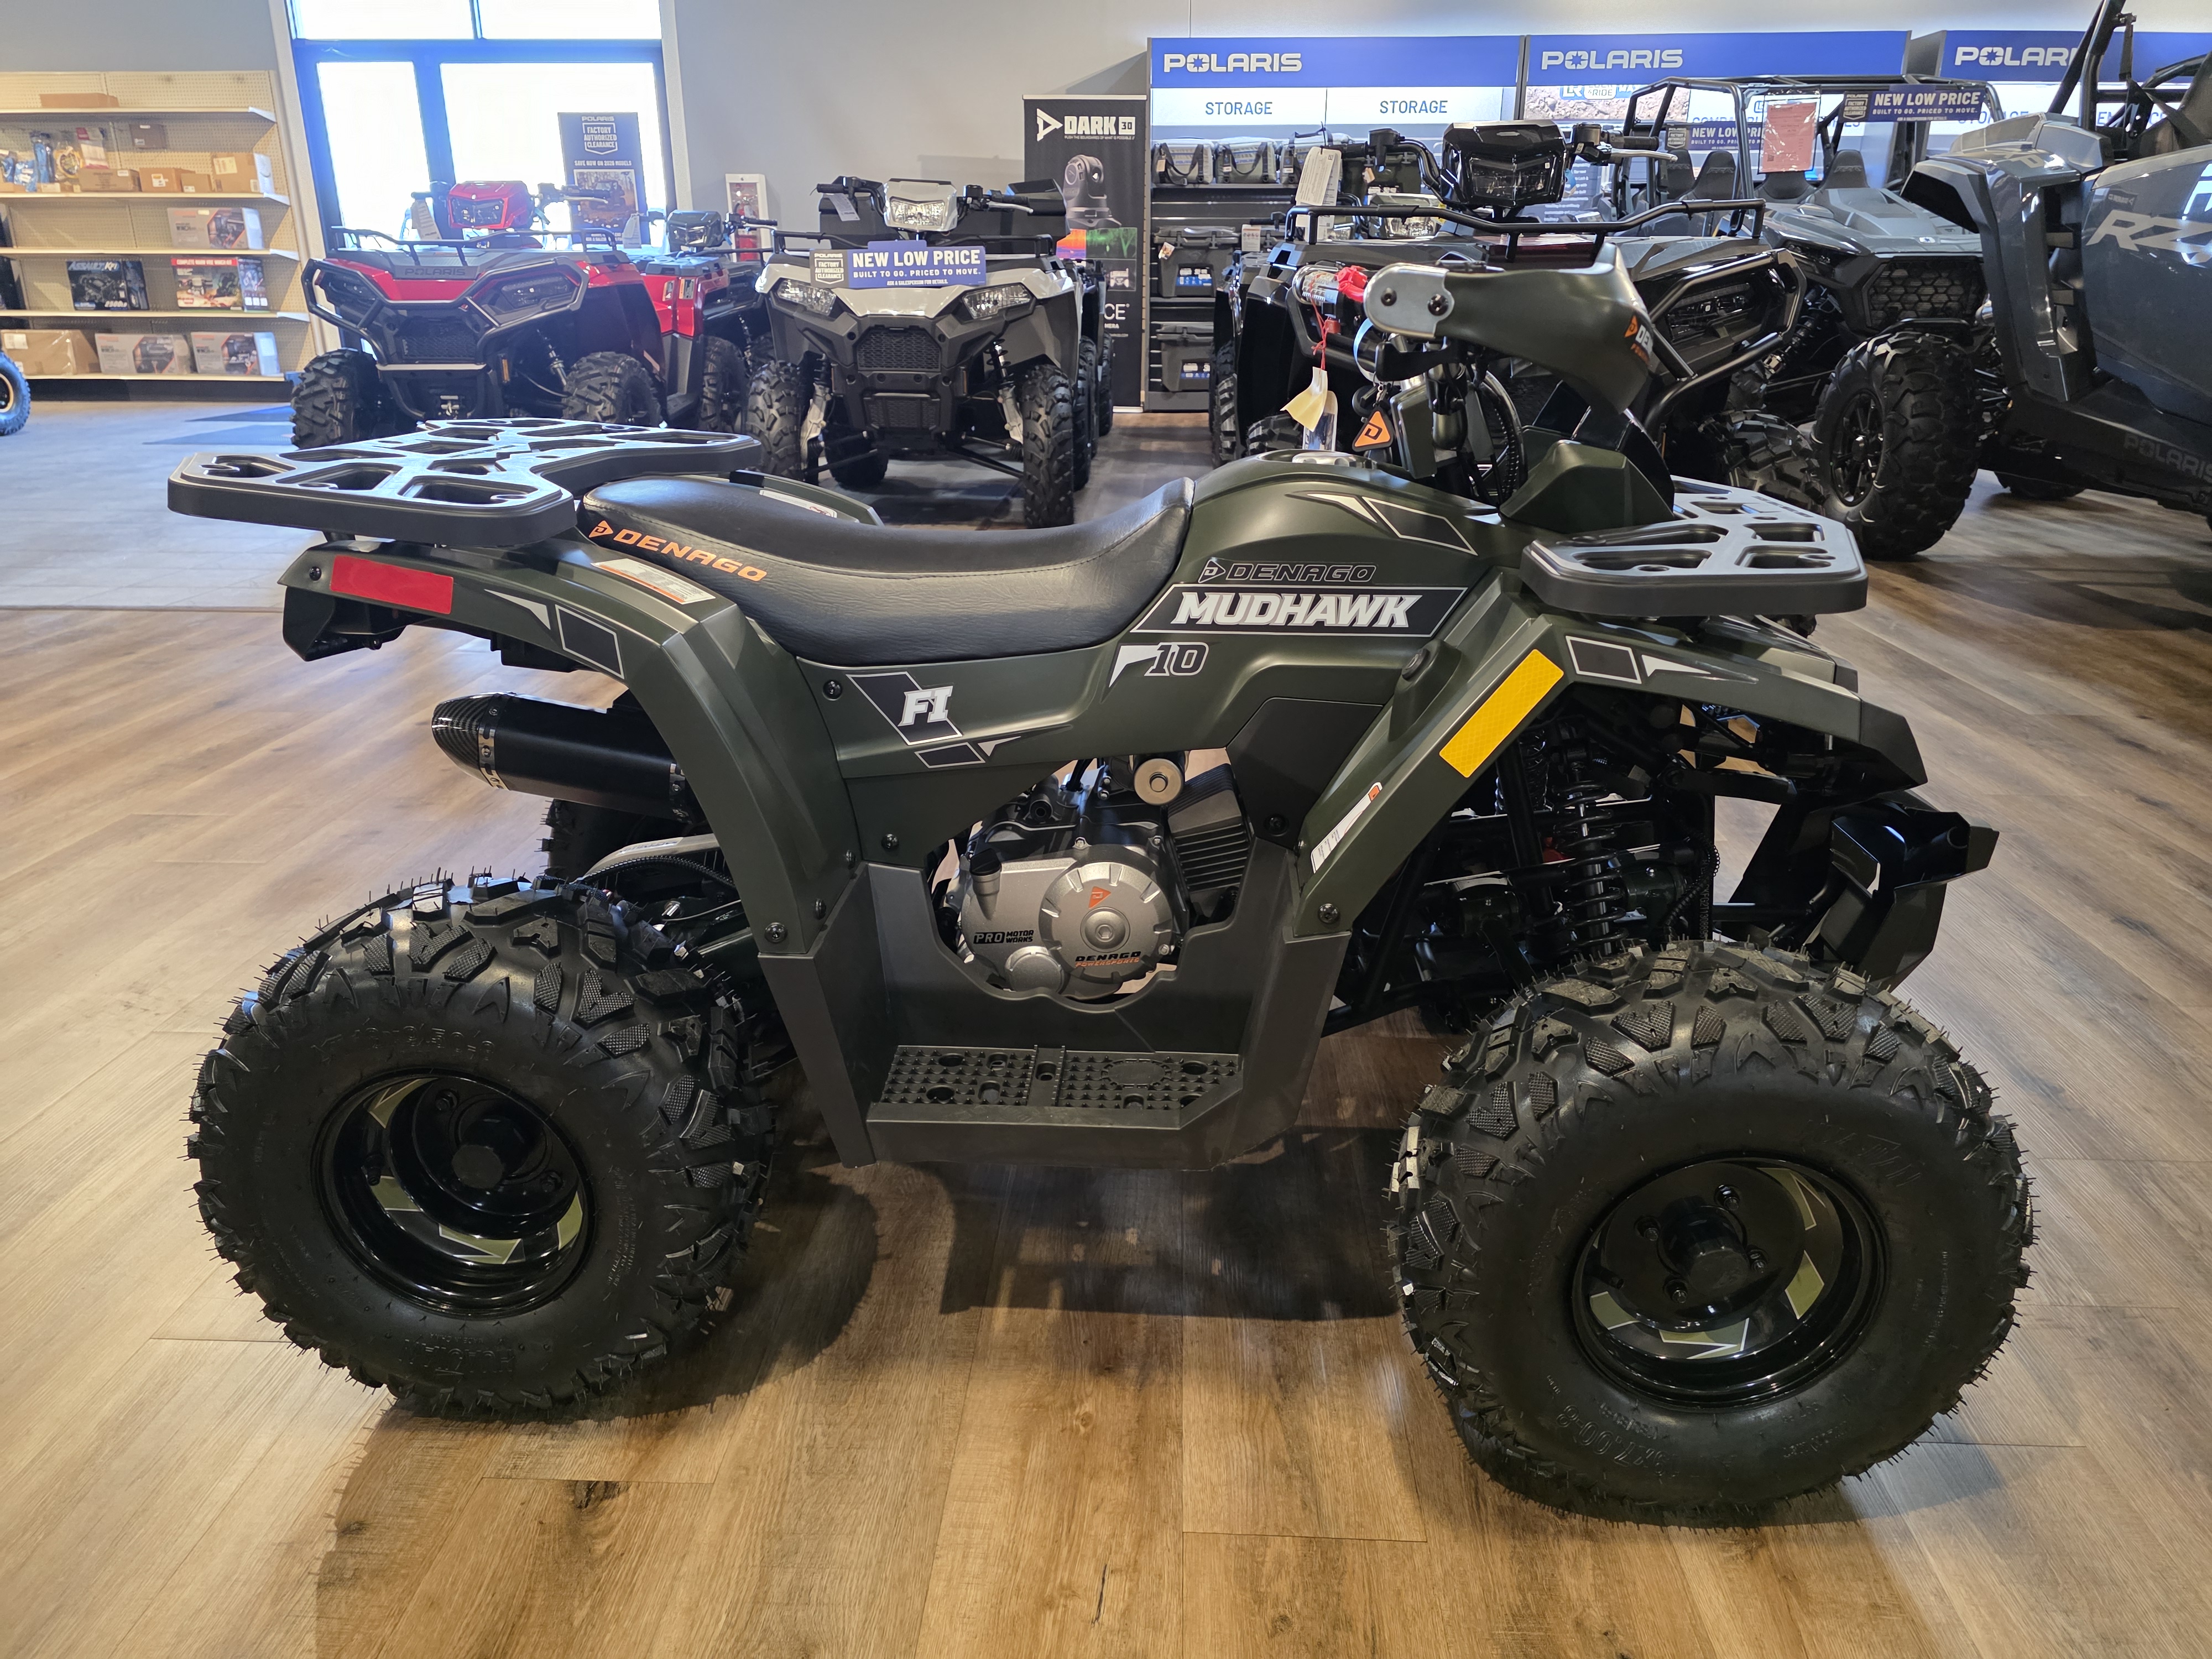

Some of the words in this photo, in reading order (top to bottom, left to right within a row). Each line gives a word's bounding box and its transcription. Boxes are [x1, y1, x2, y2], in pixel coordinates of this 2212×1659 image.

[1164, 53, 1302, 72] POLARIS
[1541, 49, 1683, 70] POLARIS
[1954, 46, 2078, 66] POLARI
[1205, 102, 1272, 115] STORAGE
[1380, 100, 1448, 114] STORAGE
[1874, 93, 1904, 106] NEW
[1907, 93, 1936, 106] LOW
[1938, 92, 1981, 105] PRICE
[1065, 116, 1117, 135] DARK
[1121, 122, 1133, 130] 30
[1692, 128, 1716, 138] NEW
[852, 252, 889, 268] NEW
[894, 251, 928, 267] LOW
[933, 249, 980, 265] PRICE
[405, 268, 465, 276] POLARIS
[2124, 432, 2212, 483] POLARIS
[613, 529, 767, 581] DENAGO
[1226, 563, 1378, 582] DENAGO
[1171, 592, 1422, 628] MUDHAWK
[1144, 642, 1209, 676] 10
[975, 932, 1005, 943] PRO
[1074, 957, 1140, 967] POWERSPORTS
[1075, 951, 1141, 962] DENAGO
